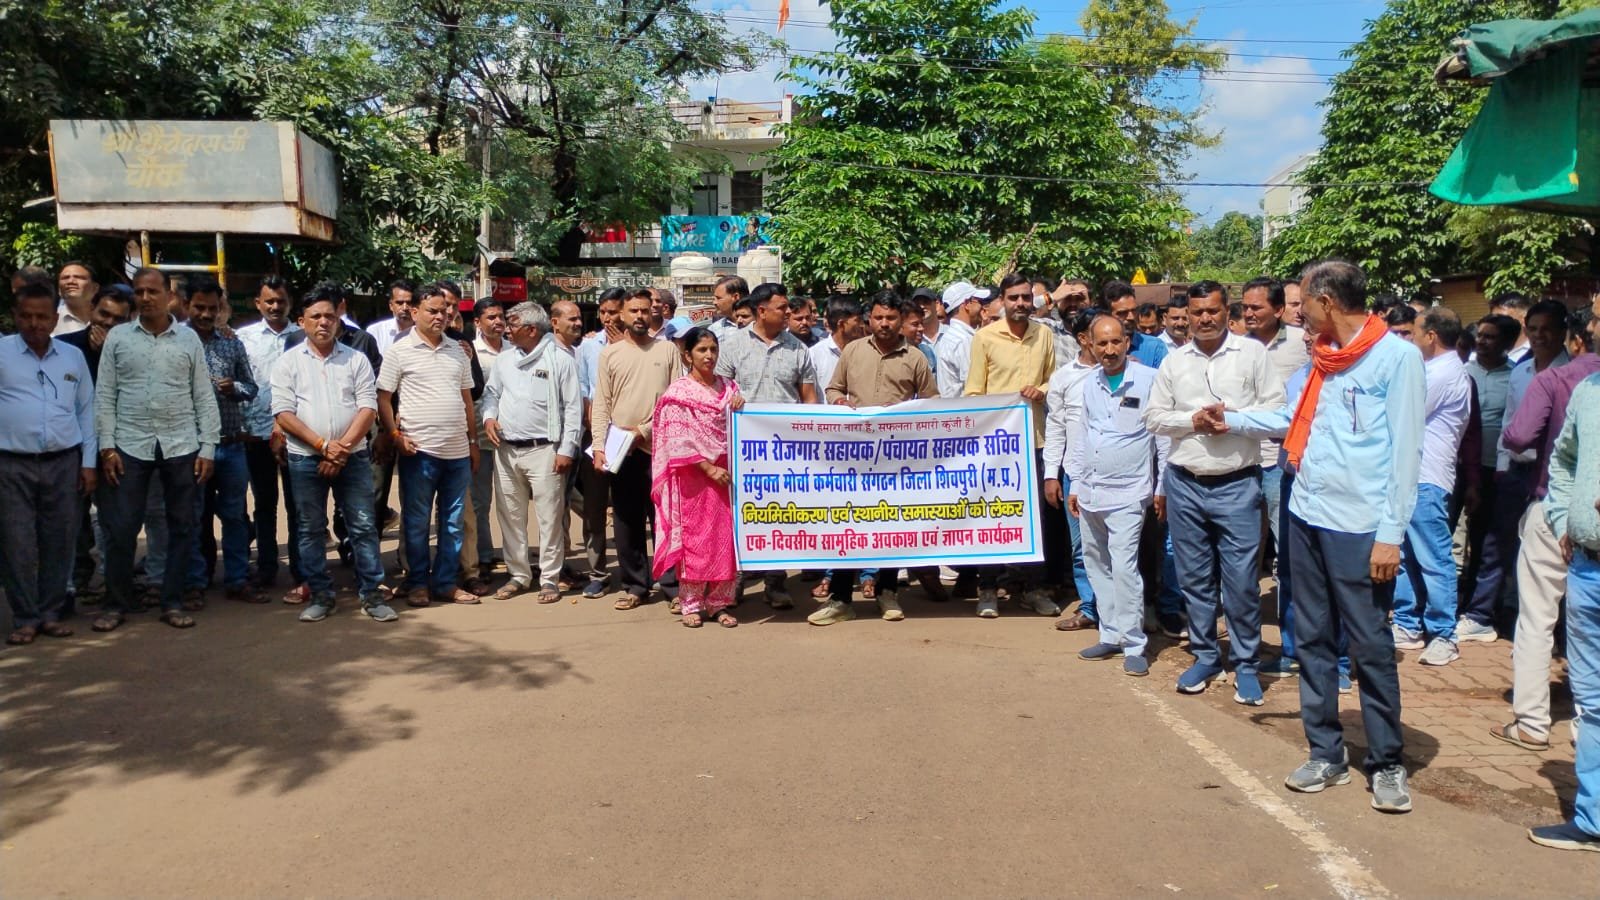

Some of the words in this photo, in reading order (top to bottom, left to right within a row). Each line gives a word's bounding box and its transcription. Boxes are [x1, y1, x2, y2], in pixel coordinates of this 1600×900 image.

[721, 256, 738, 264] BAB
[817, 423, 841, 433] हमारा
[844, 423, 863, 433] नारा
[878, 421, 913, 432] सफलता
[915, 418, 939, 430] हमारी
[941, 416, 962, 432] कुंजी
[741, 440, 768, 461] ग्राम
[771, 433, 820, 461] रोजगार
[932, 436, 980, 459] सहायक
[984, 428, 1020, 455] सचिव
[743, 468, 780, 500] संयुक्त
[783, 467, 809, 493] मोर्चा
[813, 466, 857, 492] कर्मचारी
[861, 467, 897, 492] संगठन
[901, 466, 932, 491] जिला
[935, 463, 977, 496] शिवपुरी
[742, 501, 829, 524] नियमितीकरण
[830, 501, 852, 523] एवं
[853, 499, 899, 523] स्थानीय
[901, 497, 968, 521] समास्याओं
[969, 496, 988, 519] को
[989, 496, 1024, 518] लेकर
[746, 529, 818, 551] एक-दिवसीय
[821, 528, 868, 556] सामूहिक
[872, 531, 918, 549] अवकाश
[921, 526, 940, 549] एवं
[942, 529, 974, 547] ज्ञापन
[977, 521, 1023, 546] कार्यक्रम
